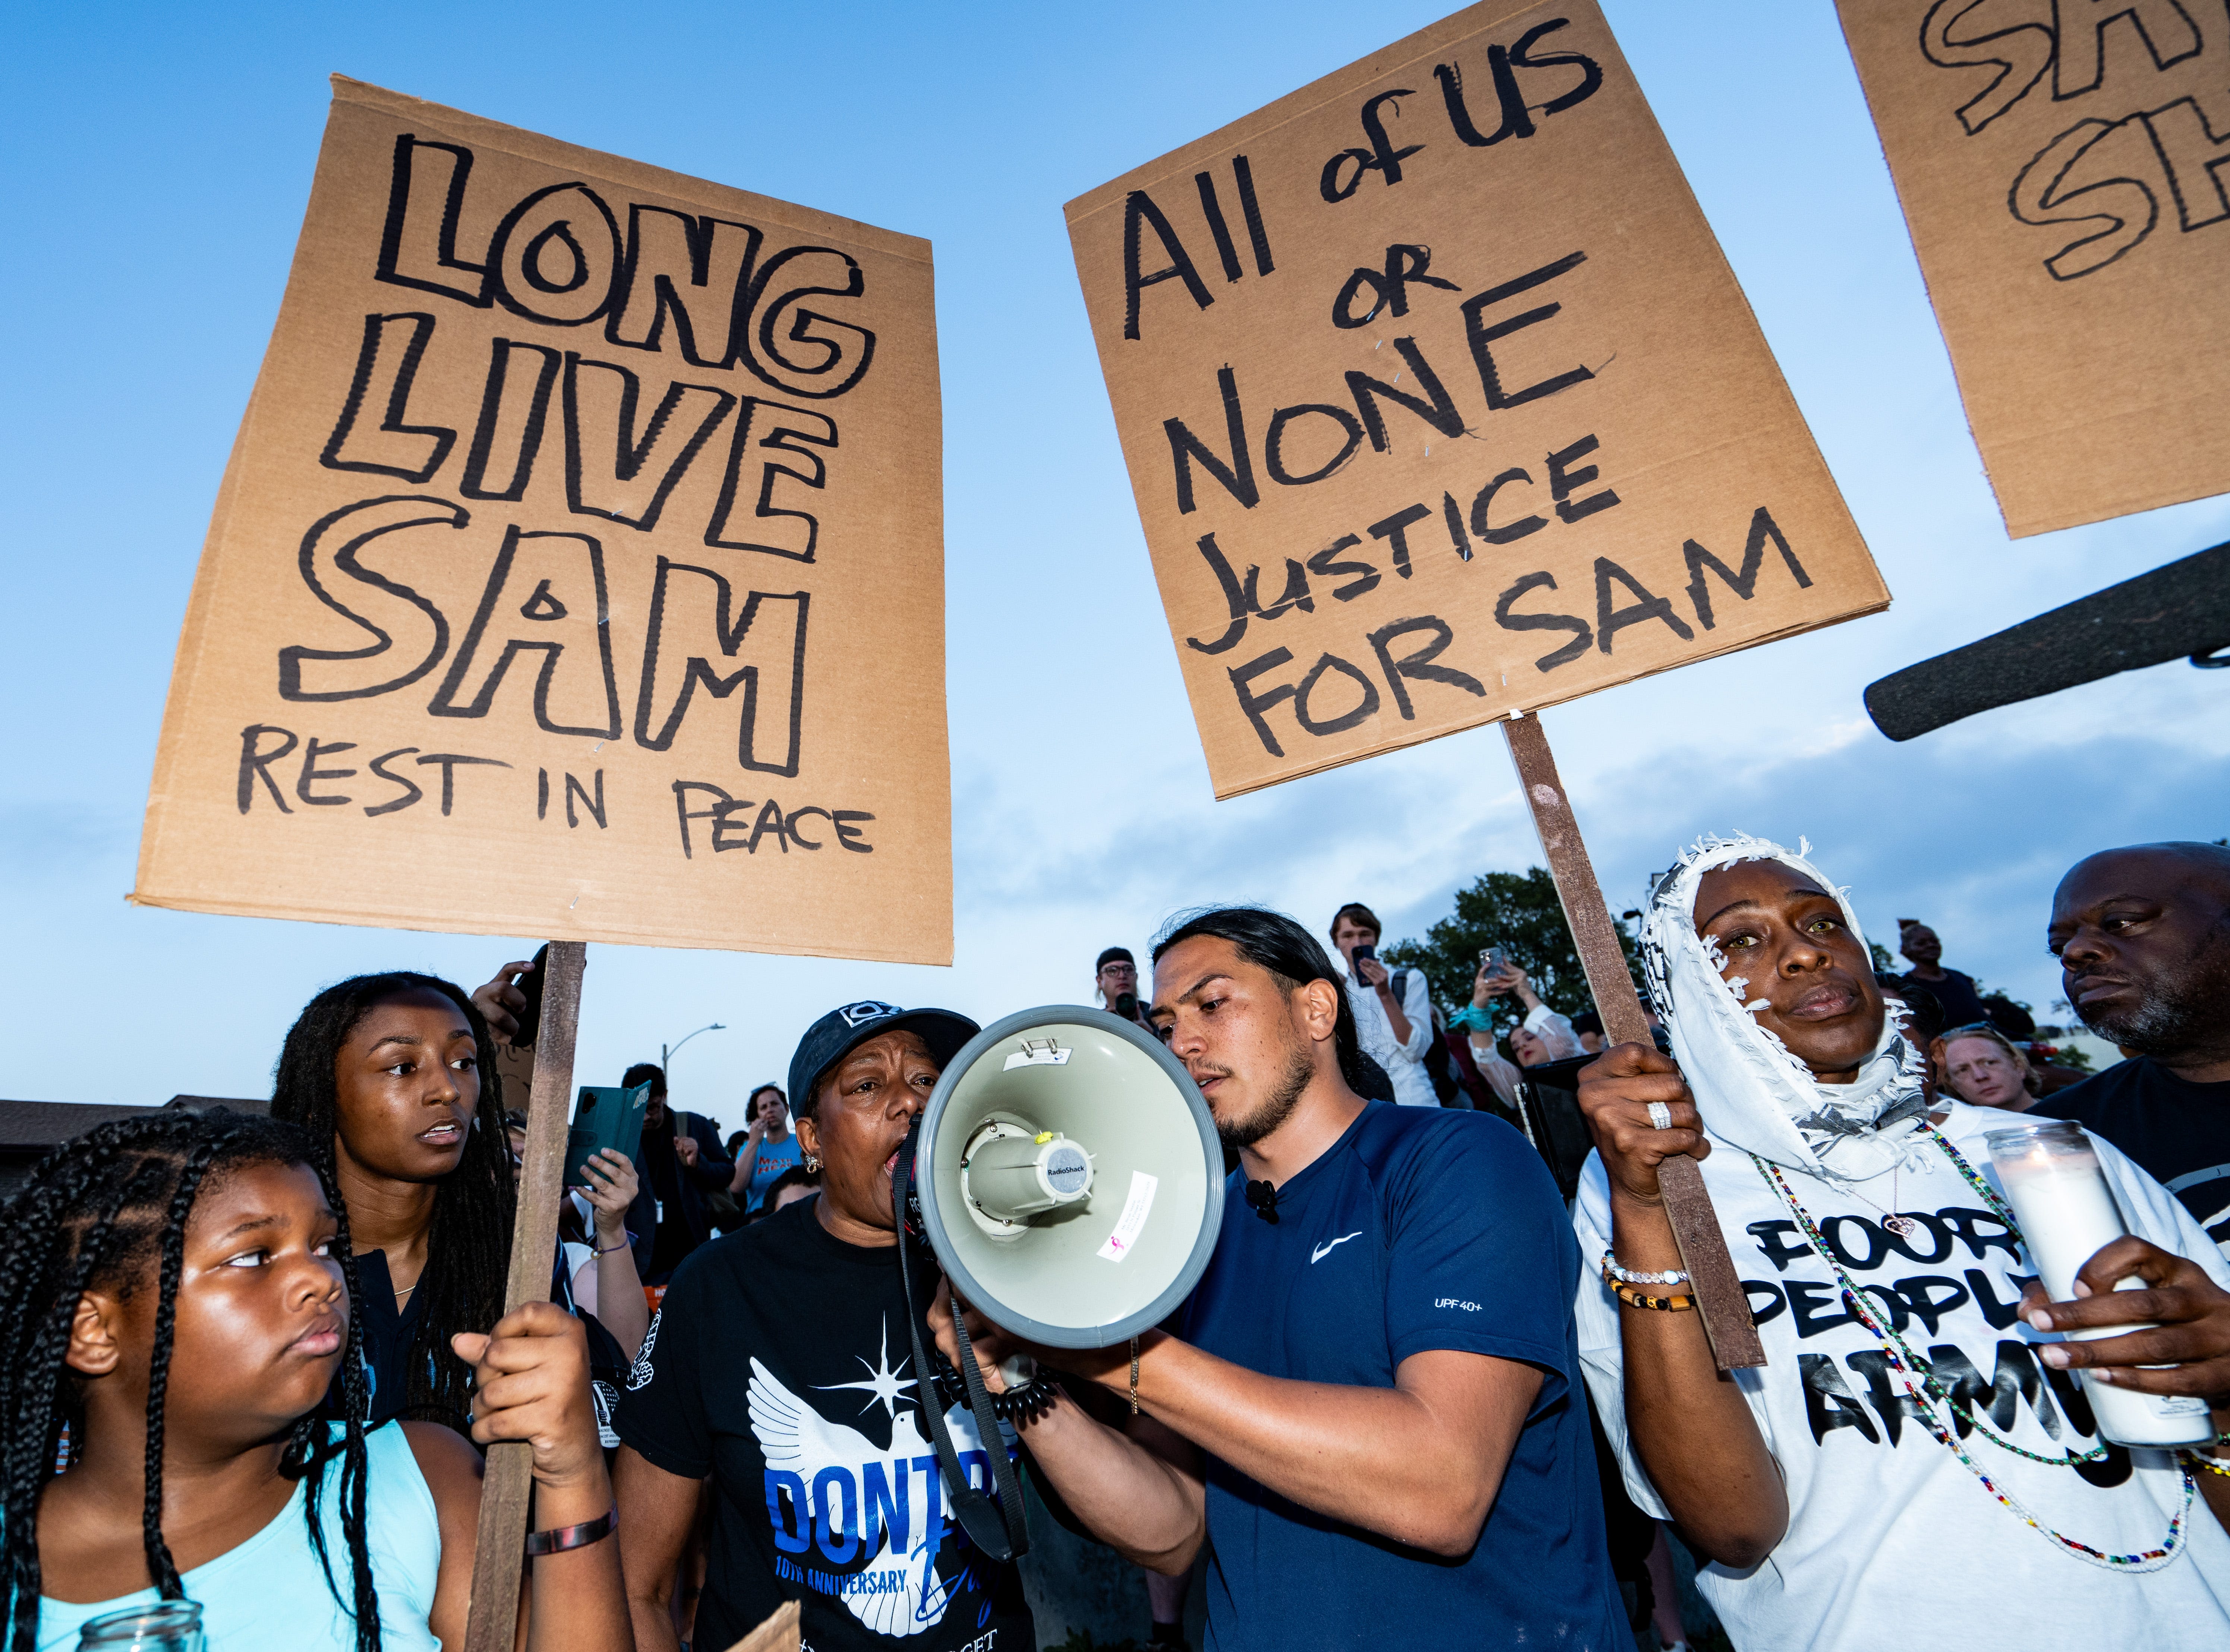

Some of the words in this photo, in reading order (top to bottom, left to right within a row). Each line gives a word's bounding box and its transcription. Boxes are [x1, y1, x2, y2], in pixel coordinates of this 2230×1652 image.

[1920, 0, 2230, 135] SA
[375, 133, 876, 399] LONG
[1123, 154, 1275, 341] All
[1320, 89, 1426, 203] of
[319, 312, 839, 563] LIVE
[278, 495, 810, 778] SAM
[1226, 615, 1487, 757] FOR
[1494, 506, 1814, 673] SAM
[237, 724, 512, 818] REST
[538, 767, 607, 830] IN
[672, 780, 877, 860] PEACE
[1048, 1166, 1085, 1176] RadioShack
[1435, 1298, 1459, 1308] UPF
[1459, 1301, 1483, 1311] 40+
[1741, 1269, 2038, 1338] PEOPL
[776, 1555, 804, 1583] 10TH
[807, 1569, 907, 1595] ANNIVERSARY
